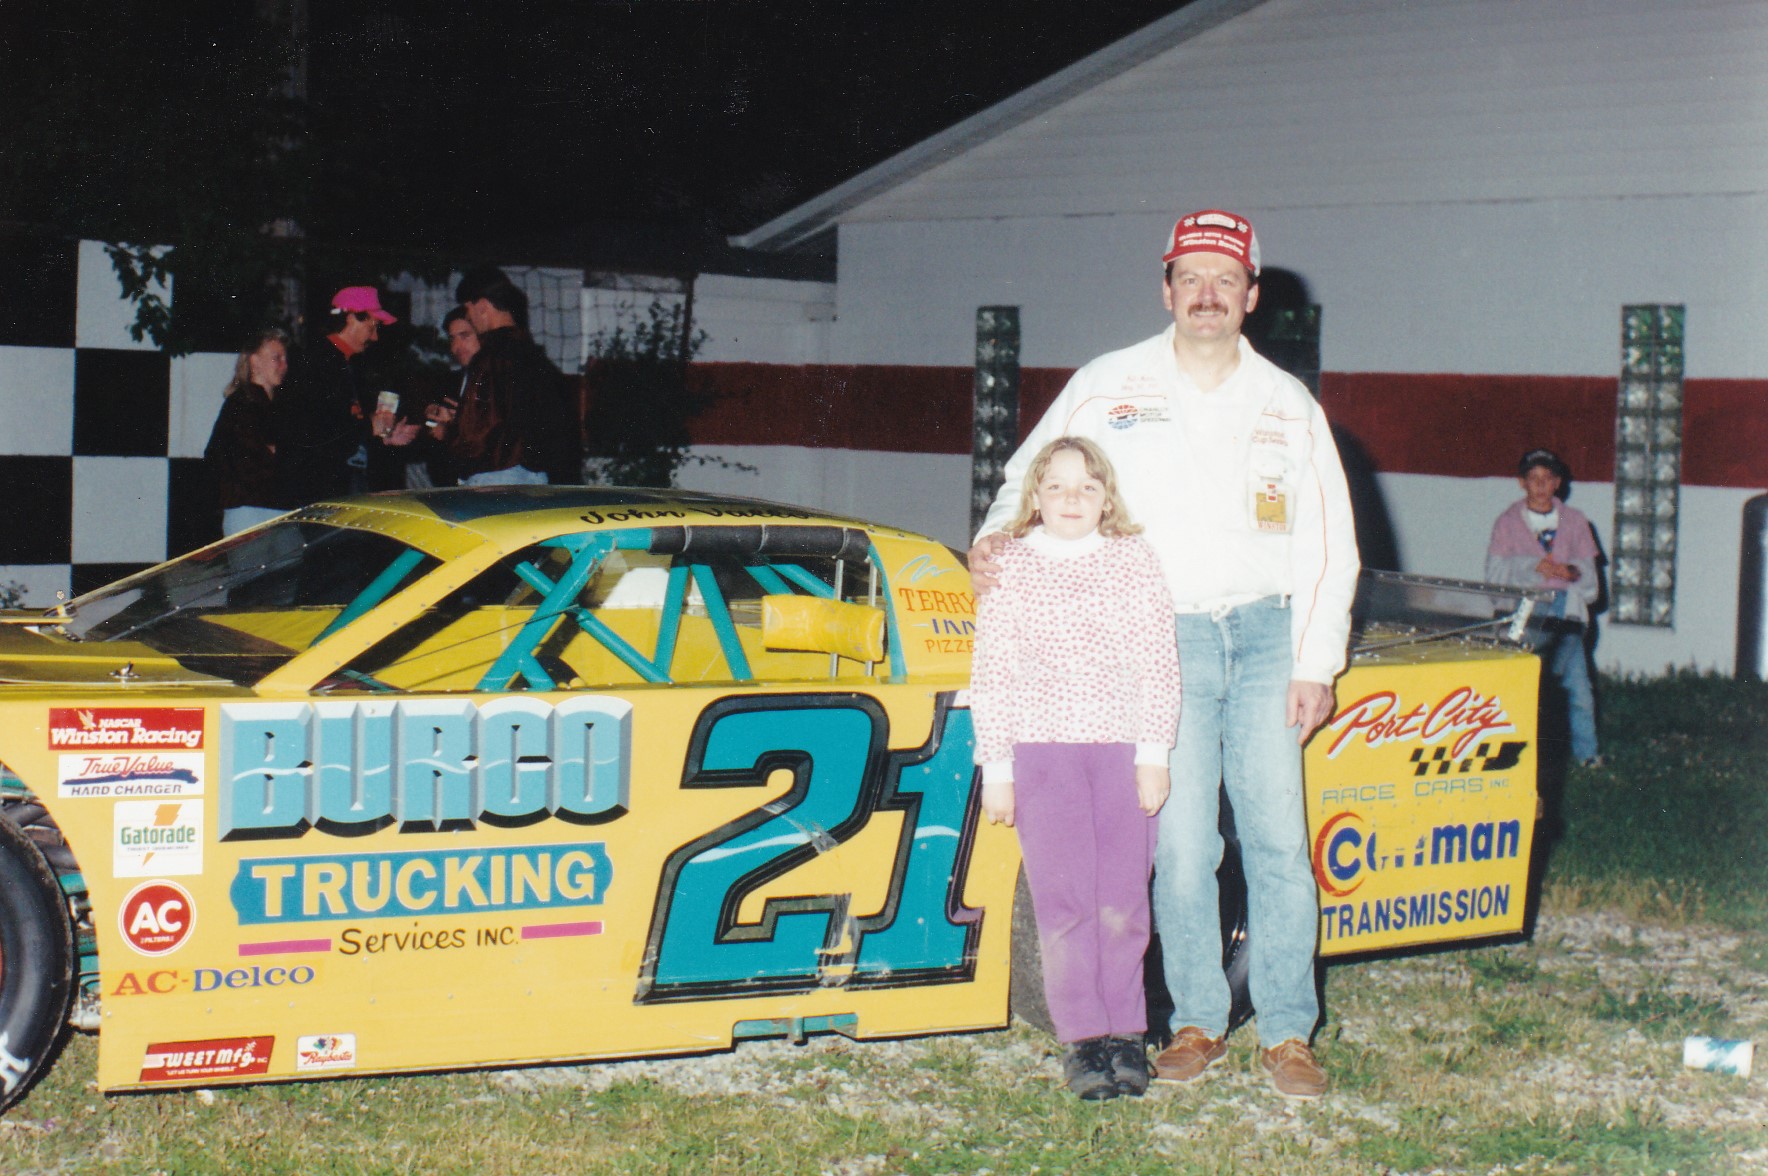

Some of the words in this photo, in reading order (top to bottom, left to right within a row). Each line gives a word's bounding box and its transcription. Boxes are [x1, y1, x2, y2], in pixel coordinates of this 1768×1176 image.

[580, 507, 685, 525] John
[51, 728, 132, 746] Winston
[132, 726, 202, 748] Racing
[98, 718, 142, 729] NASCAR
[1327, 690, 1429, 760] Port
[1421, 686, 1516, 764] City
[218, 694, 634, 843] BURCO
[71, 785, 110, 796] HARD
[114, 784, 182, 795] CHARGER
[1322, 784, 1396, 805] RACE
[1414, 778, 1483, 796] CARS
[121, 824, 196, 846] Gatorade
[633, 690, 985, 1006] 21
[251, 851, 596, 918] TRUCKING
[130, 900, 182, 935] AC
[1322, 884, 1511, 941] TRANSMISSION
[338, 921, 467, 956] Services
[476, 926, 519, 947] INC.
[110, 965, 316, 996] AC-Delco
[155, 1049, 216, 1069] SWEET
